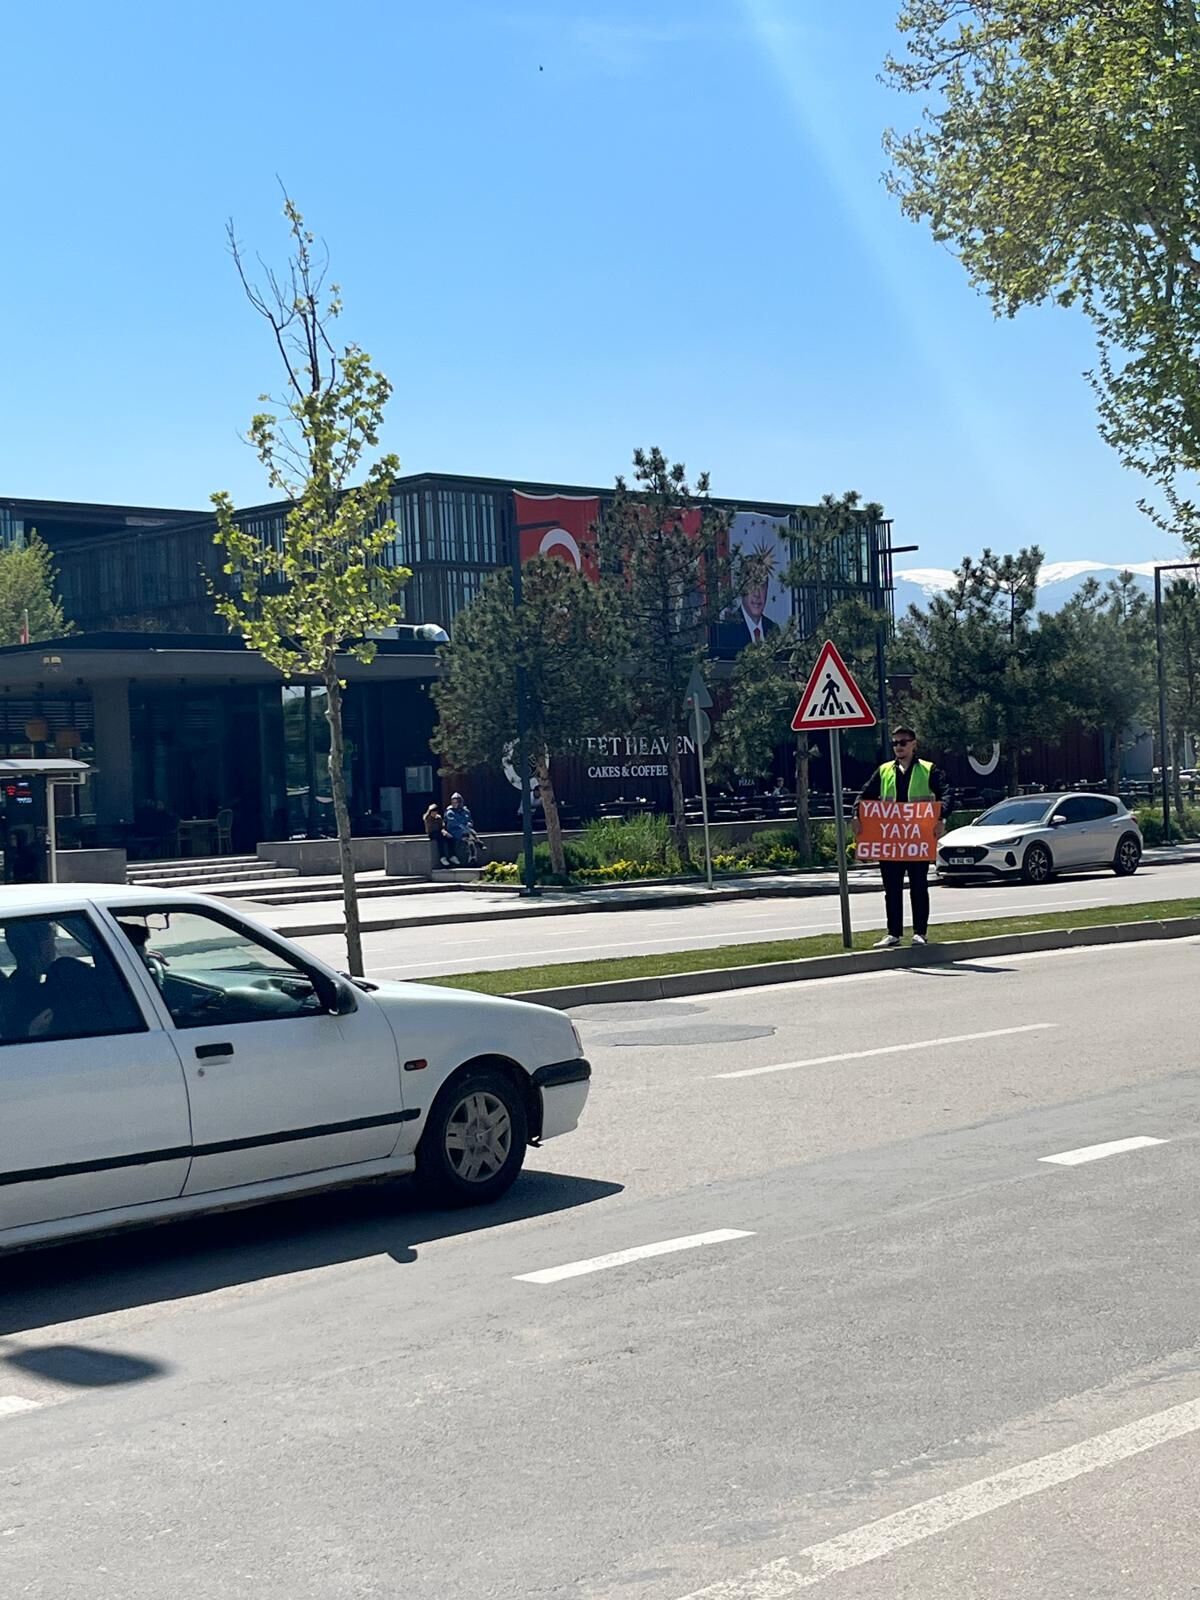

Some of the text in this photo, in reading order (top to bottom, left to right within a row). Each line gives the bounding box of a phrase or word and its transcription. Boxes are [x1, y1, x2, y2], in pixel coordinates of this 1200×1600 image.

[588, 764, 669, 778] CAKES & COFFEE
[862, 802, 934, 821] YAVAŞLA
[880, 823, 921, 839] YAYA
